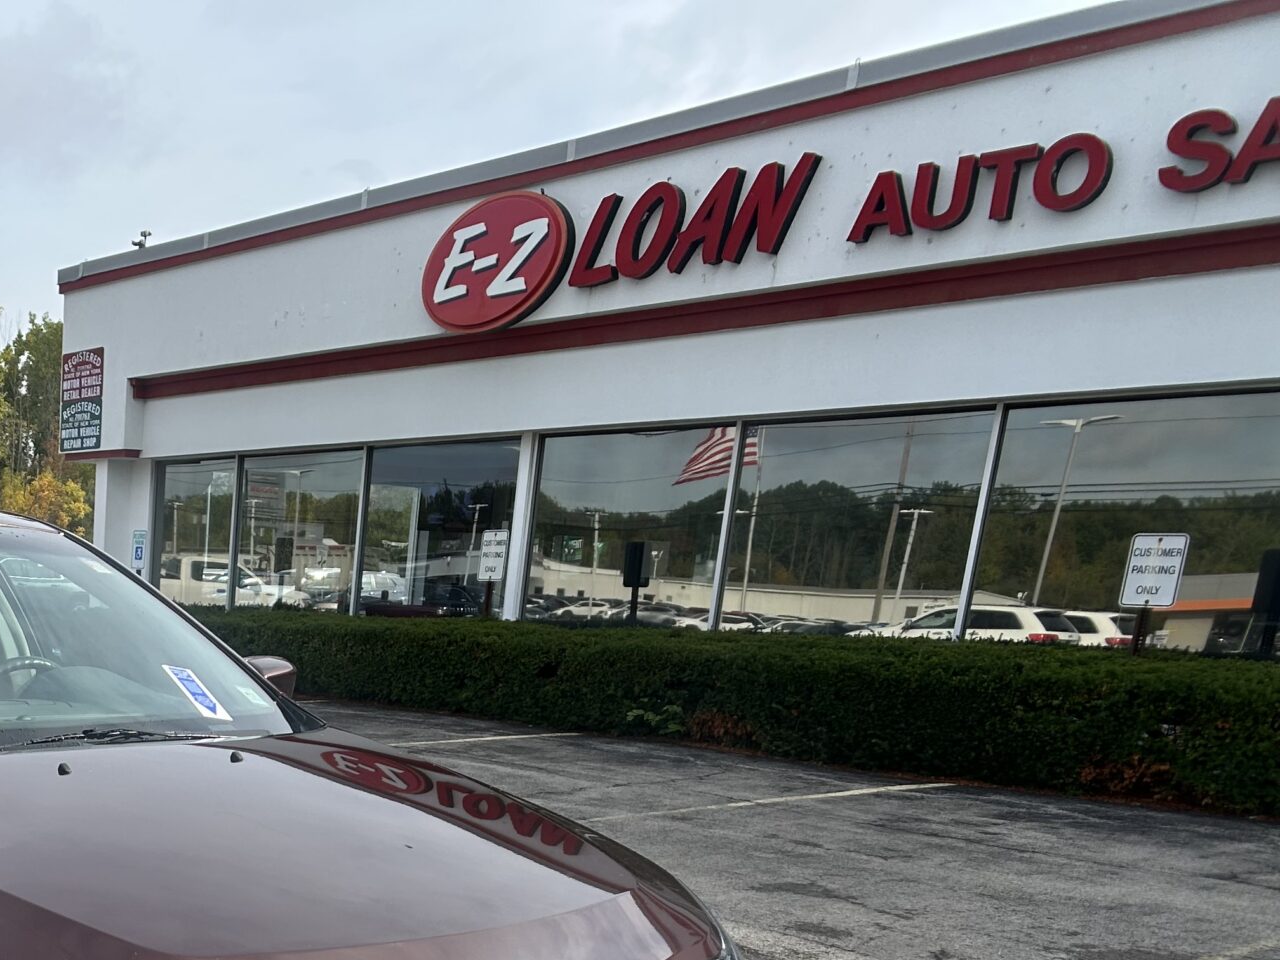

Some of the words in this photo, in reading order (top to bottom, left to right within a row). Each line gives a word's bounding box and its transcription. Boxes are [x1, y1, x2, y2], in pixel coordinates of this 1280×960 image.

[433, 217, 549, 304] E-Z
[568, 151, 823, 289] LOAN
[846, 132, 1114, 244] AUTO
[64, 351, 102, 372] REGISTERED
[62, 378, 80, 391] MOTOR
[81, 374, 102, 388] VEHICLE
[63, 372, 75, 380] STATE
[63, 389, 80, 401] RETAIL
[81, 386, 100, 398] DEALER
[62, 401, 100, 420] REGISTERED
[61, 428, 79, 439] MOTOR
[80, 425, 100, 437] VEHICLE
[63, 438, 81, 449] REPAIR
[83, 437, 97, 447] SHOP
[482, 551, 503, 559] PARKING
[1133, 547, 1183, 557] CUSTOMER
[1131, 565, 1176, 575] PARKING
[1135, 585, 1161, 595] ONLY
